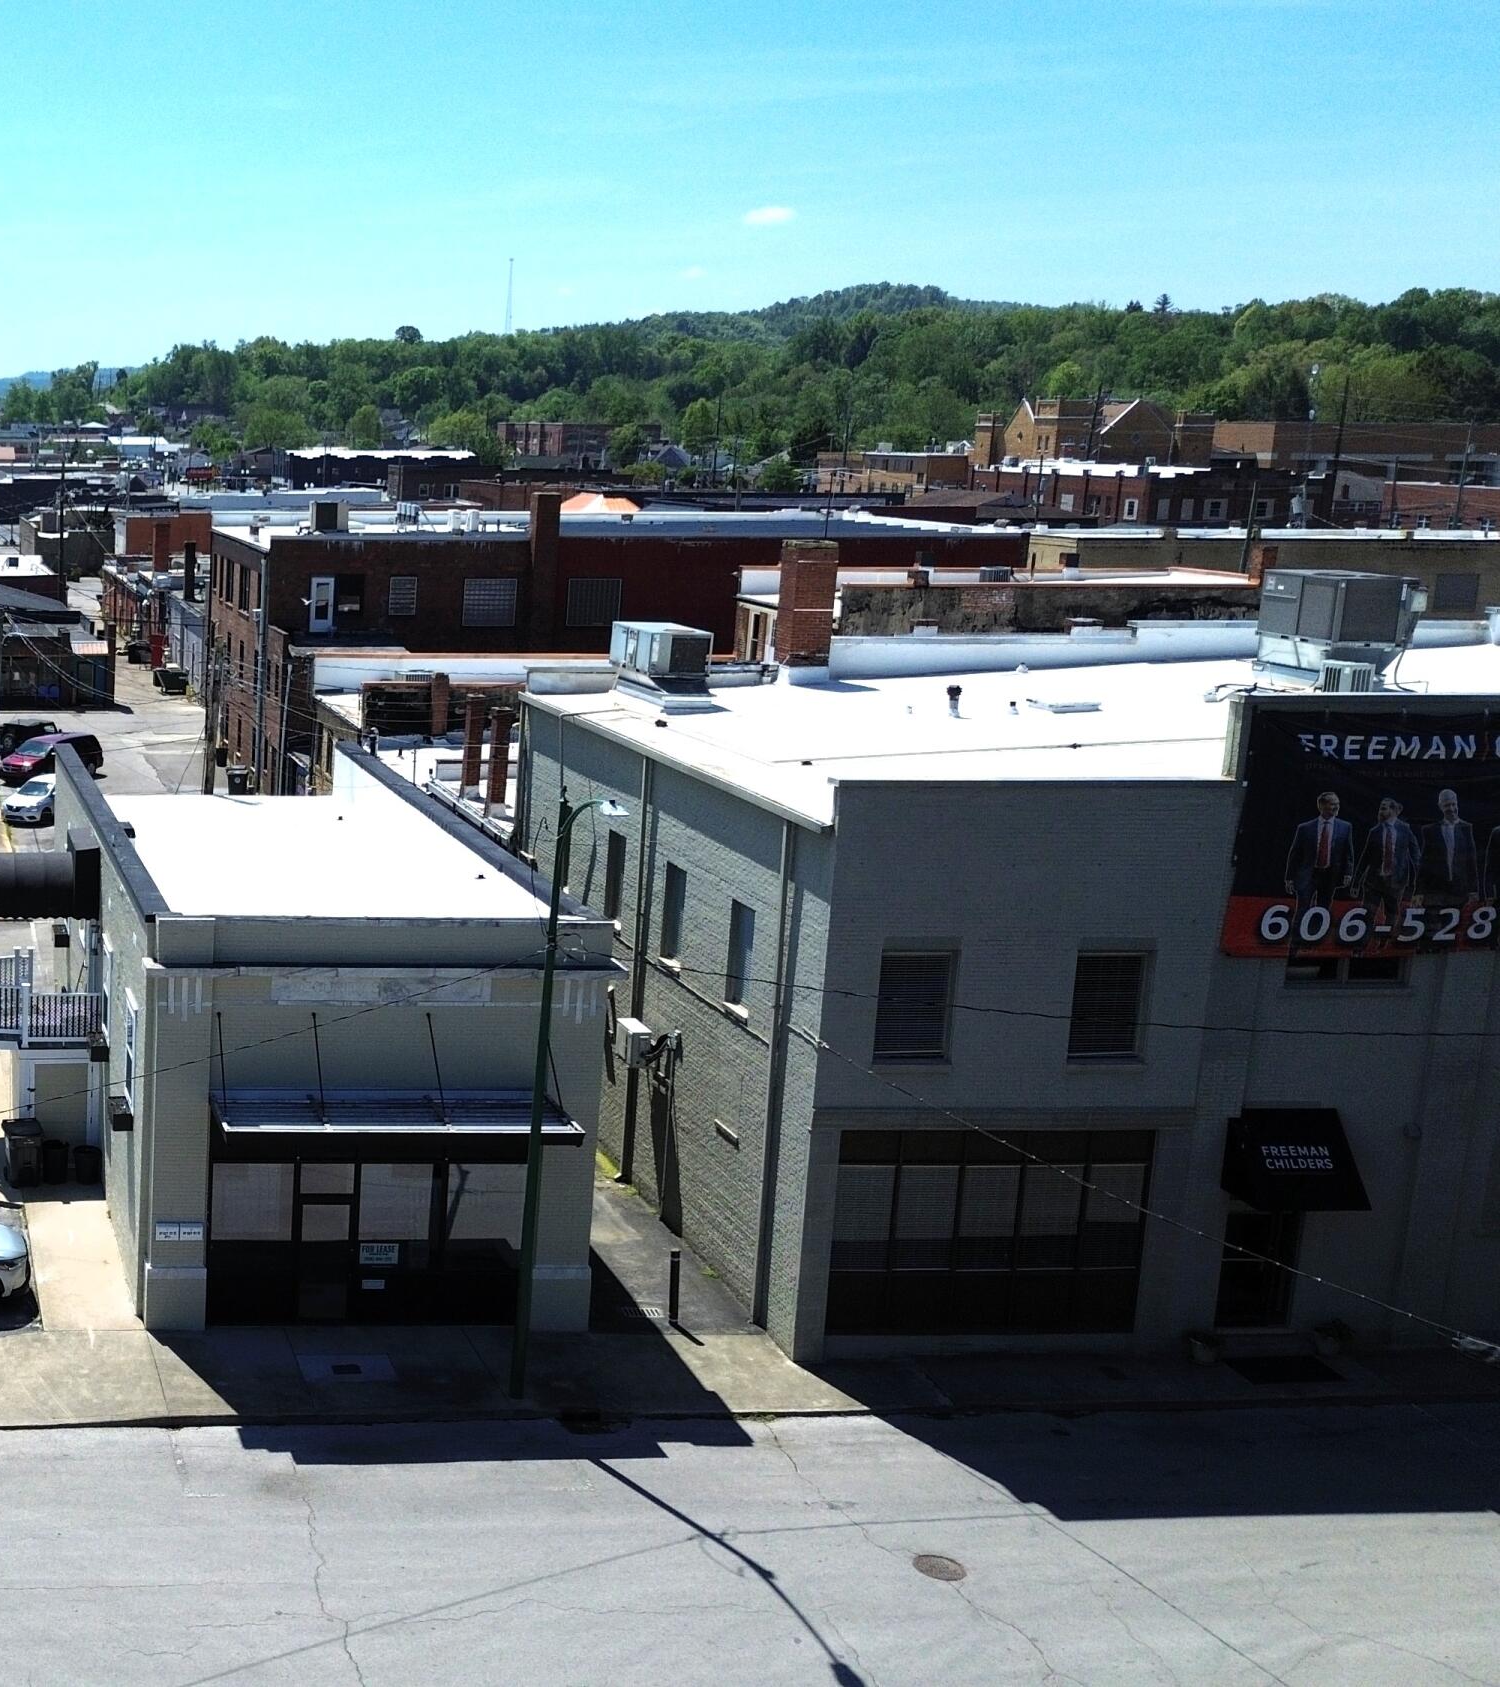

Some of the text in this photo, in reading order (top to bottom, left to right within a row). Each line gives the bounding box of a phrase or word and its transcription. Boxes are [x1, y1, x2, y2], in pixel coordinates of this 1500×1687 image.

[1297, 734, 1477, 760] FREEMAN
[1261, 1145, 1330, 1157] FREEMAN
[1265, 1158, 1334, 1169] CHILDERS
[376, 1245, 396, 1253] LEASE
